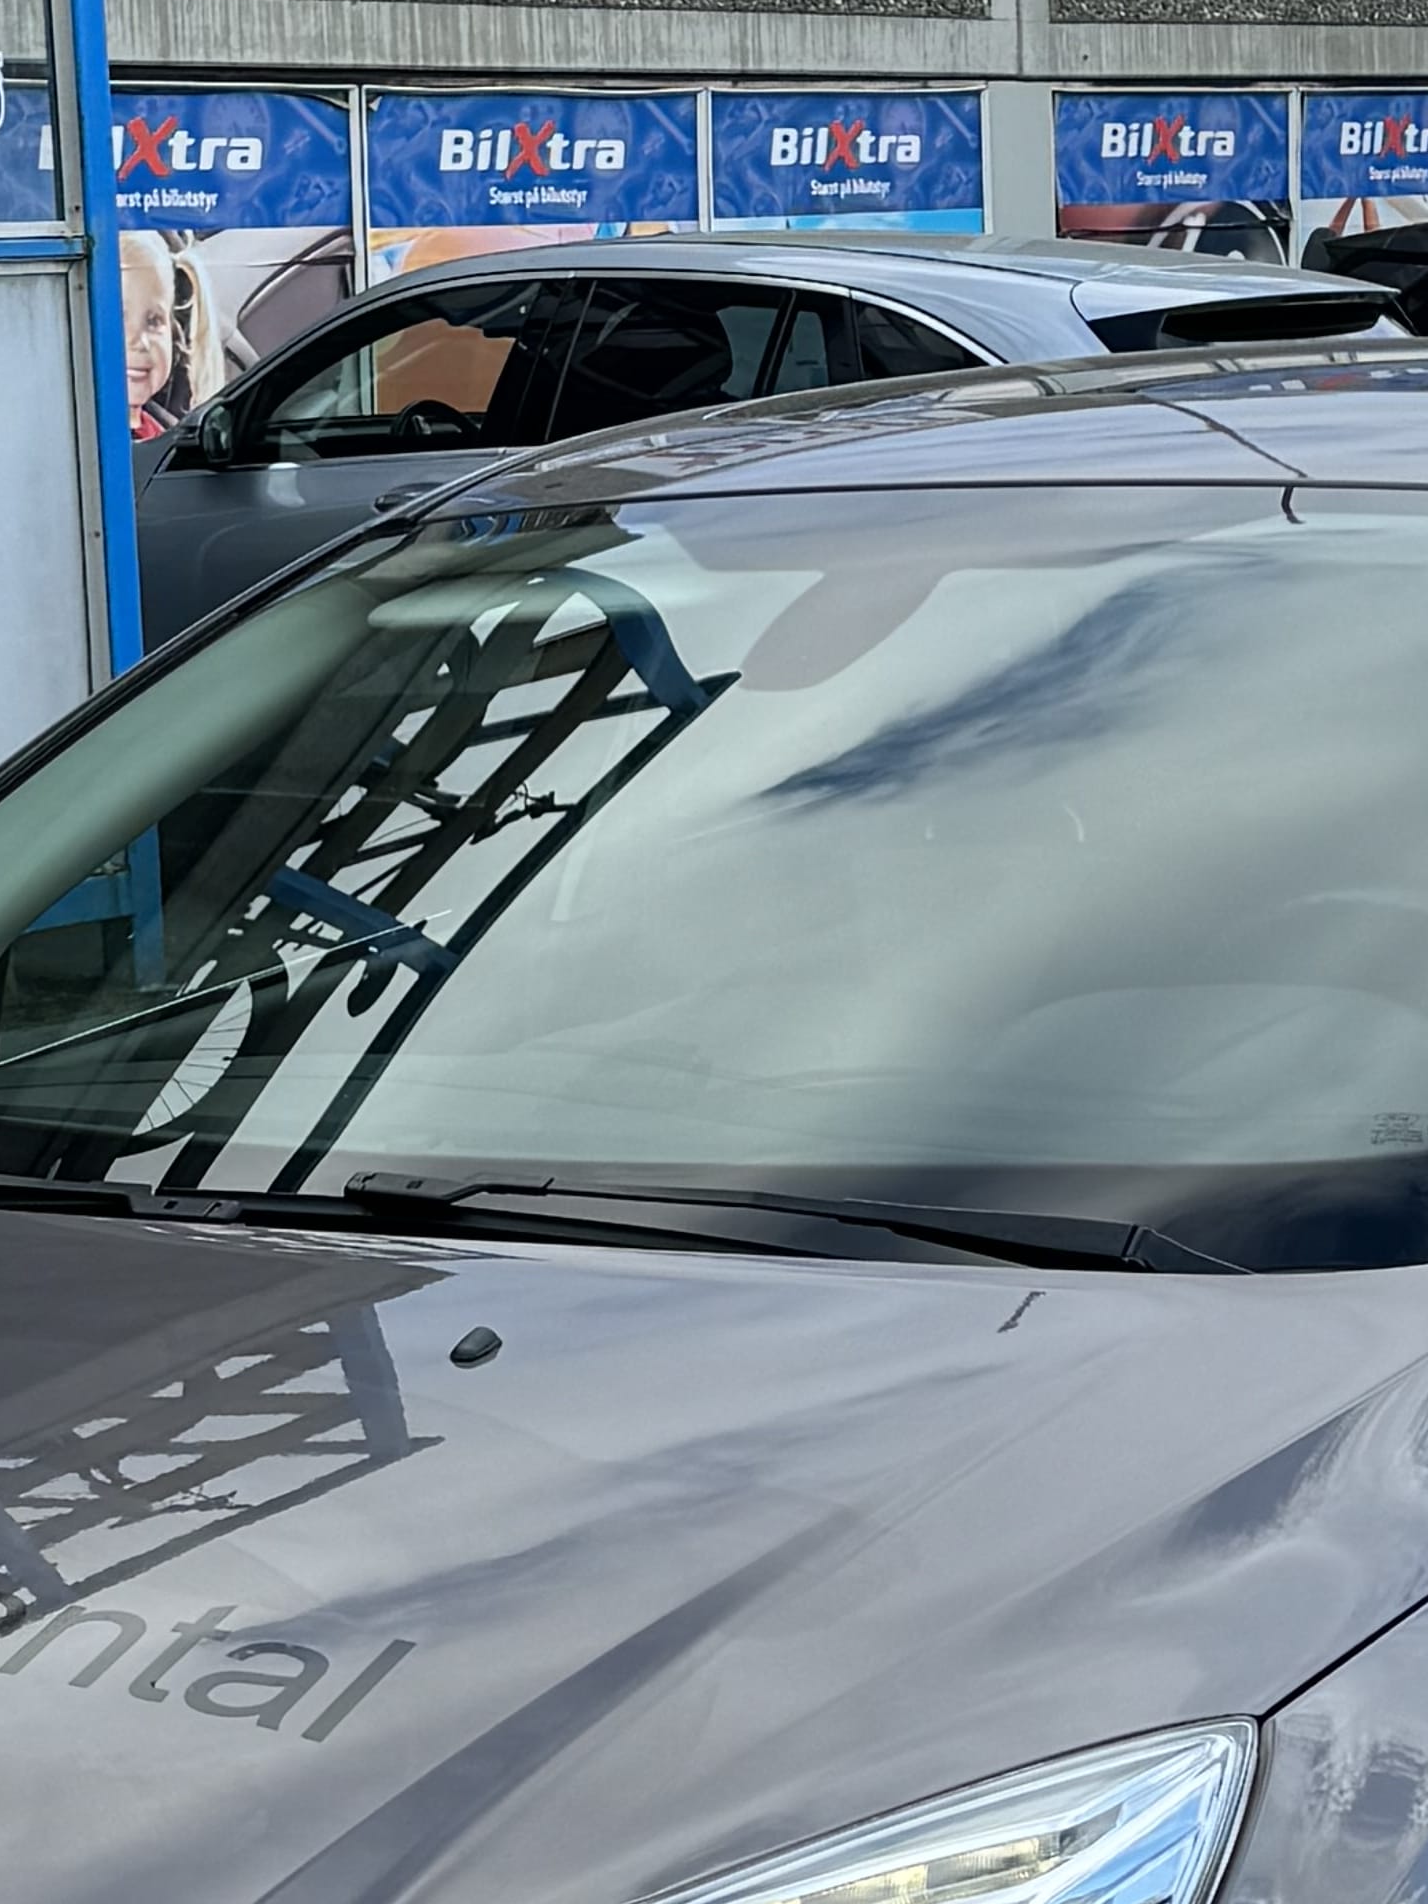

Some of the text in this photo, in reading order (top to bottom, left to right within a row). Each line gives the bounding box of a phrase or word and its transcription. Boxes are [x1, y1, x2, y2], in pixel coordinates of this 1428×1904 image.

[439, 119, 626, 181] BilXtra
[770, 118, 921, 173] BilXtra
[1101, 114, 1235, 166] BilXtra
